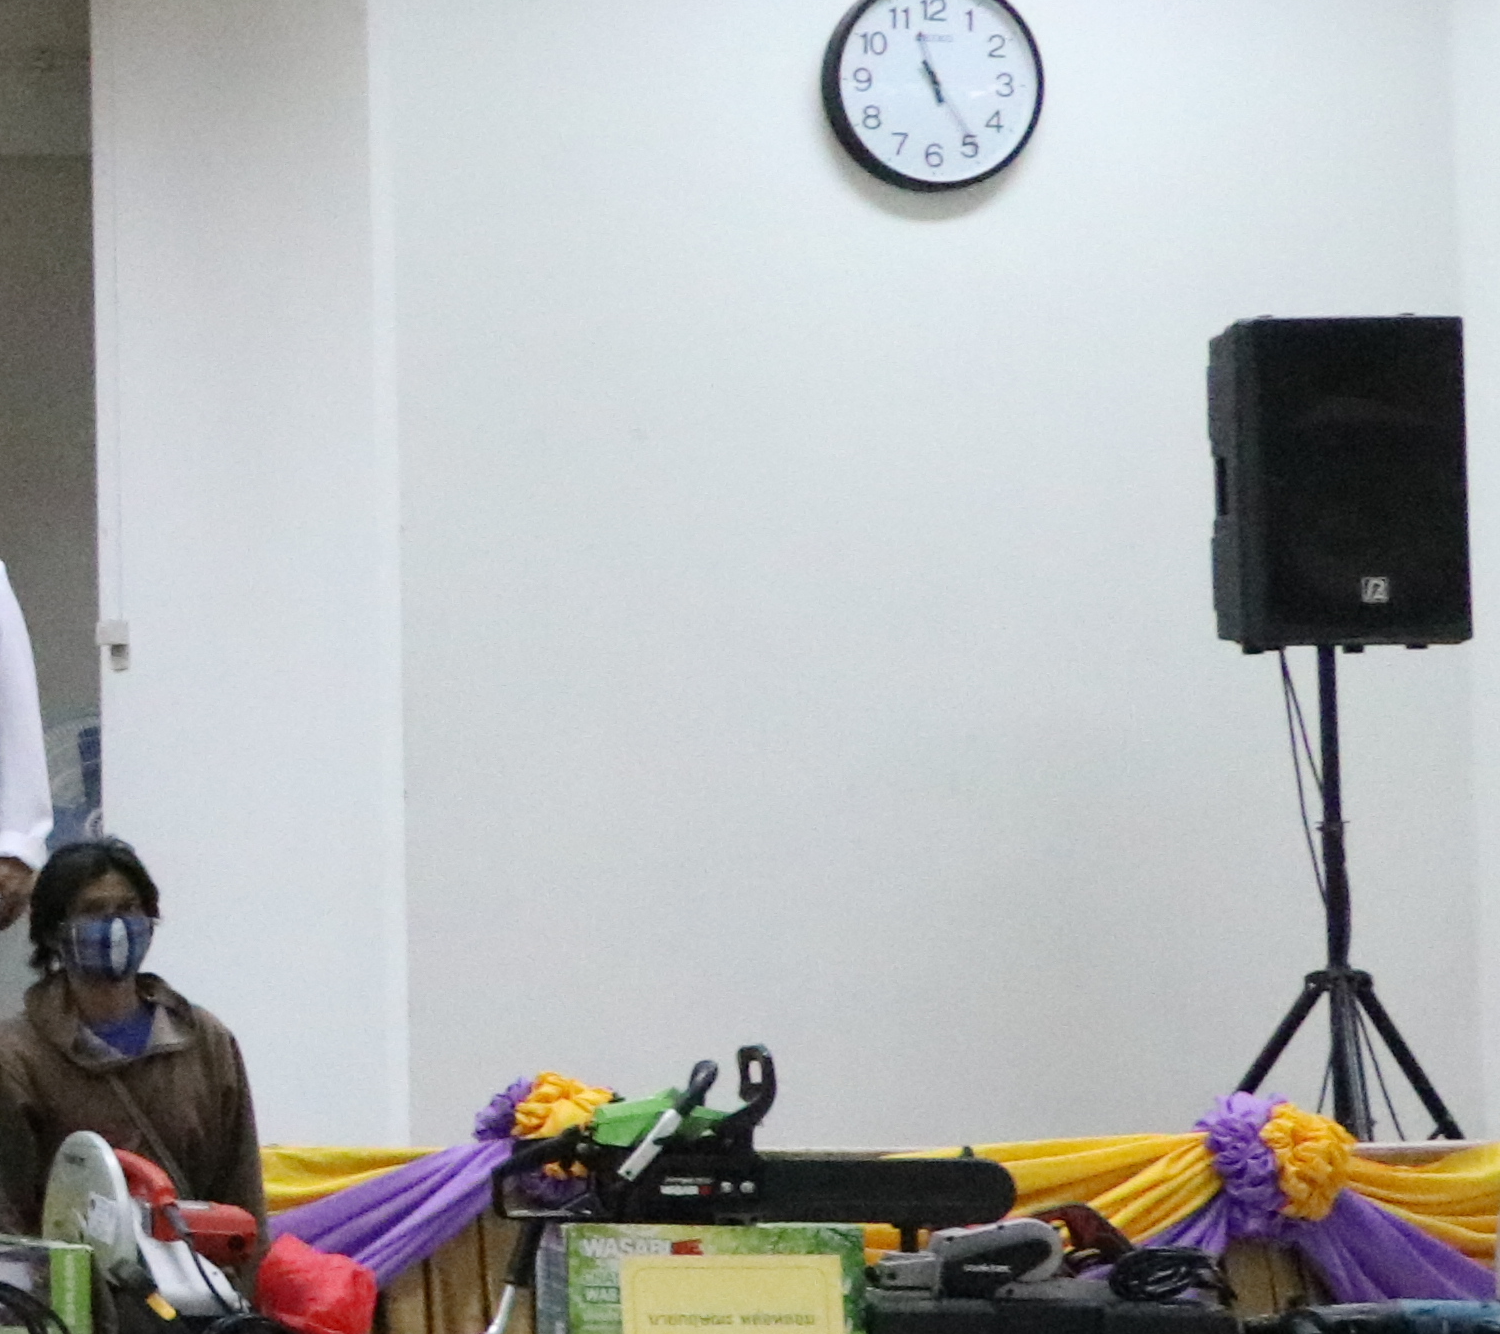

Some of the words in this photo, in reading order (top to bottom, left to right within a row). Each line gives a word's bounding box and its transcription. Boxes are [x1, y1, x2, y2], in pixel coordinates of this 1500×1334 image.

[890, 7, 910, 29] 11
[966, 9, 974, 31] 1
[860, 31, 887, 55] 10
[988, 34, 1006, 58] 2
[853, 68, 872, 91] 9
[995, 72, 1014, 97] 3
[862, 105, 882, 130] 8
[985, 110, 1004, 133] 4
[892, 132, 908, 155] 7
[925, 143, 943, 167] 6
[961, 134, 979, 158] 5
